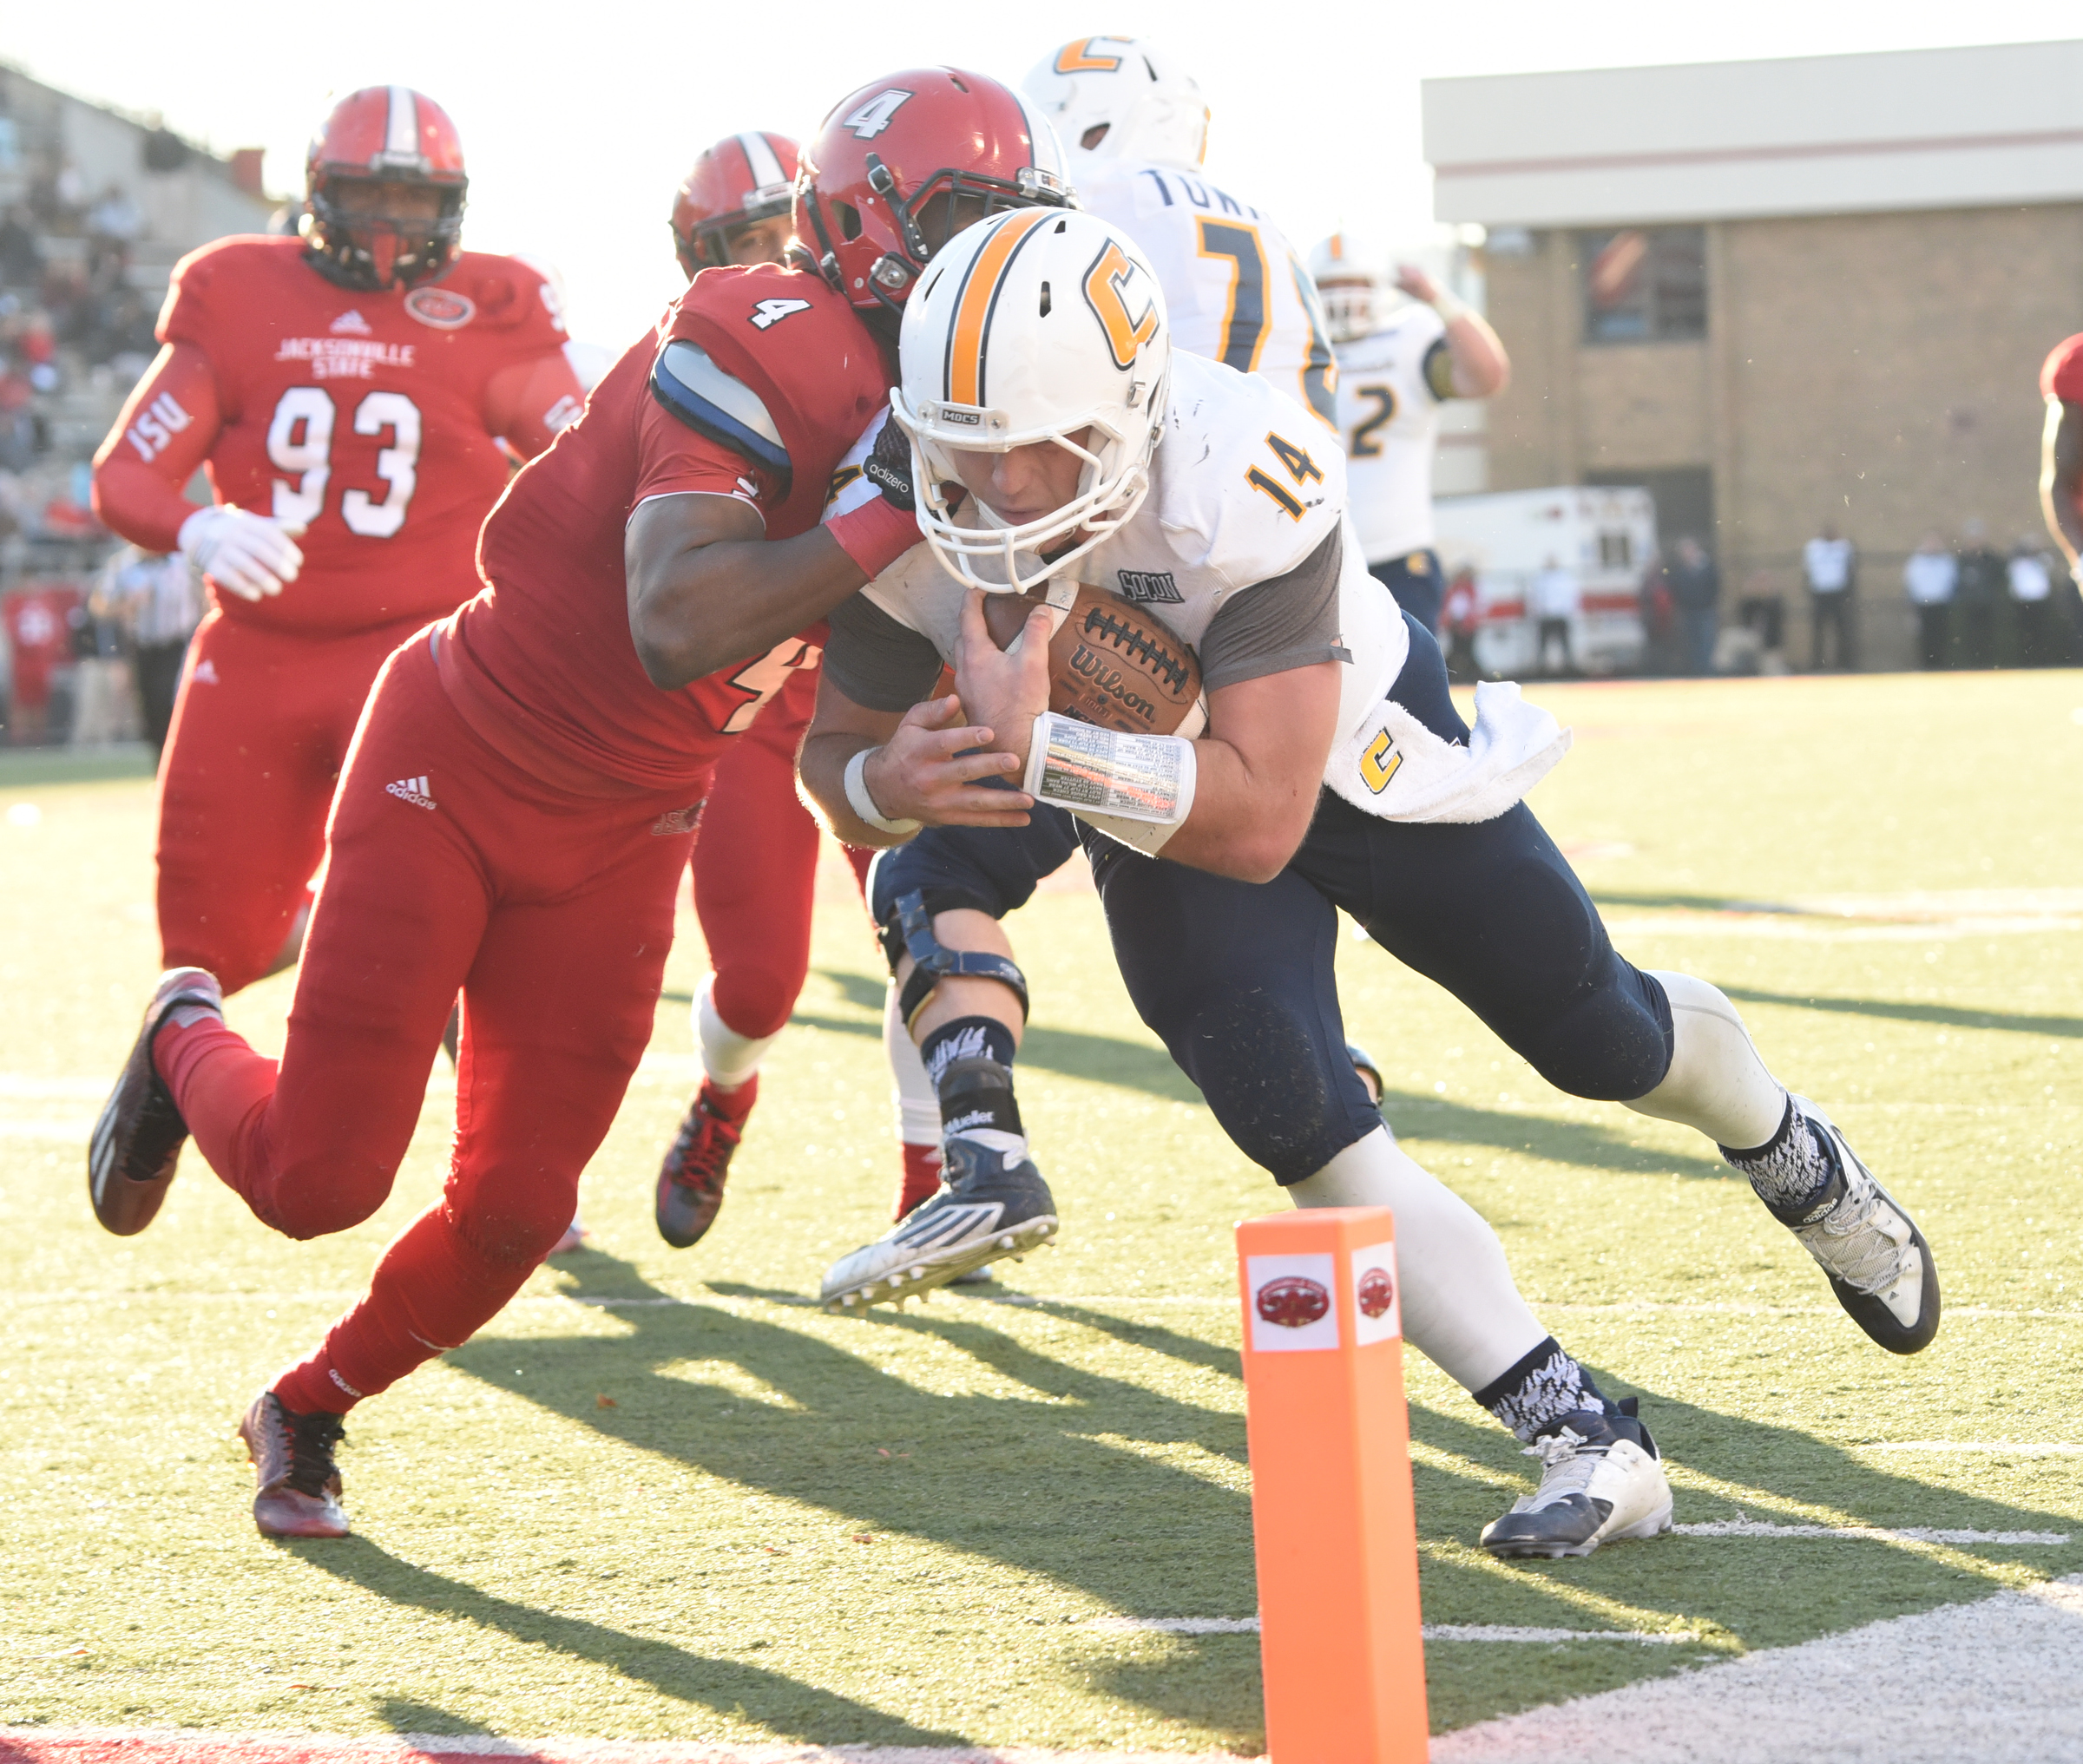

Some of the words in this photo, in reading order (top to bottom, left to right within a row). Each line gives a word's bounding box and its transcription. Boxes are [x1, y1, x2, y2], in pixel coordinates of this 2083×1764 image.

[842, 88, 917, 141] 4
[746, 298, 814, 331] 4
[1081, 236, 1160, 372] C
[273, 337, 417, 368] JACKSONVILLE
[311, 357, 377, 381] STATE
[126, 390, 190, 464] JSU
[943, 410, 979, 425] MOCS
[1350, 386, 1399, 458] 2
[266, 385, 422, 538] 93
[869, 463, 910, 493] adizero
[1244, 430, 1324, 523] 14
[1120, 571, 1182, 601] SOCON
[1068, 642, 1155, 723] Wilson
[1357, 725, 1403, 796] C
[385, 783, 437, 810] adidas
[1803, 1197, 1838, 1223] adidas
